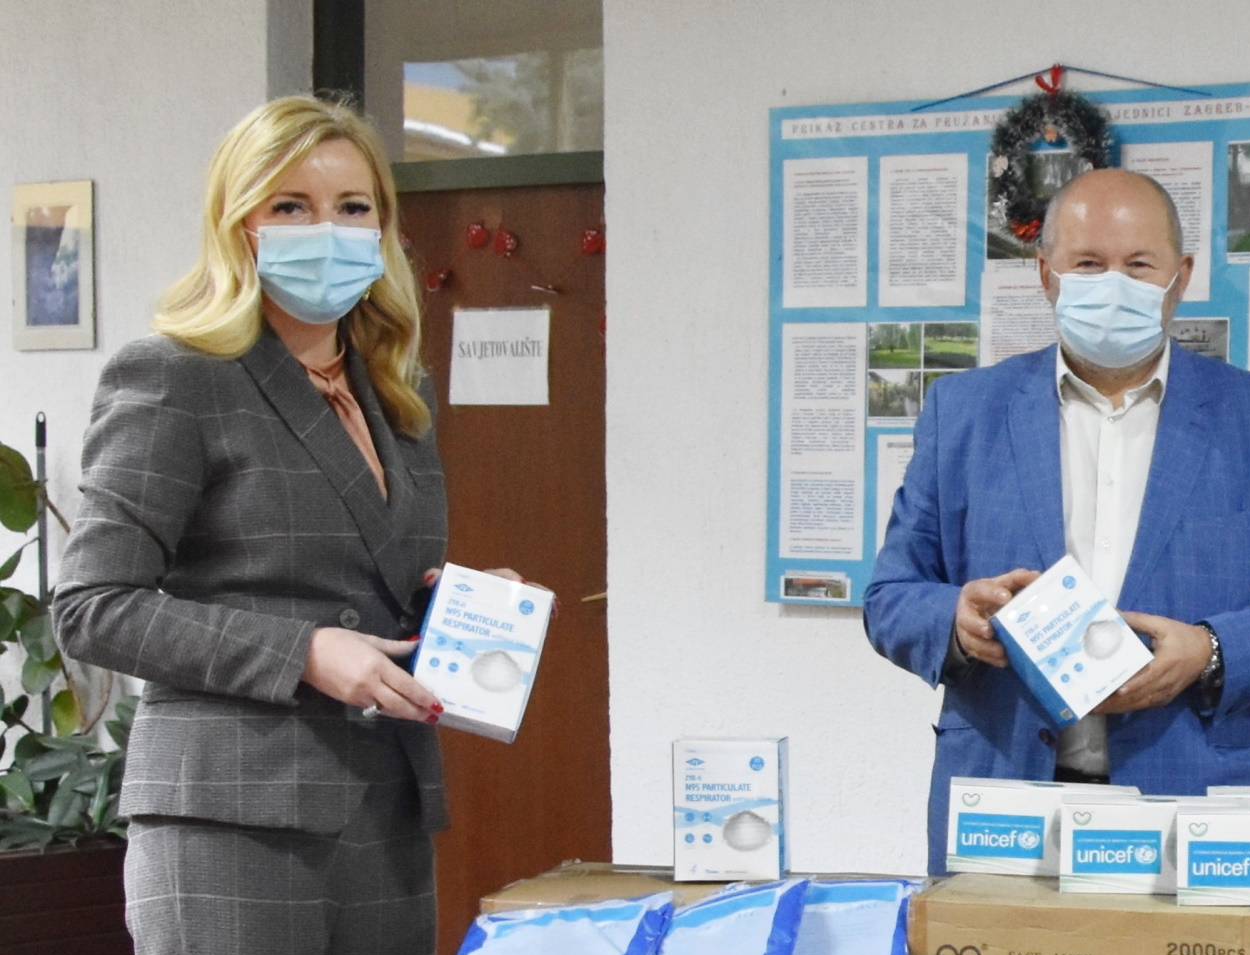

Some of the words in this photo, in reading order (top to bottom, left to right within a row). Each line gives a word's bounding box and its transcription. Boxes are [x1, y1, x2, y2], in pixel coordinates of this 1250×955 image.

[913, 118, 927, 129] ZA
[442, 617, 491, 637] RESPIRATOR
[463, 609, 514, 634] PARTICULATE
[685, 783, 700, 792] N95
[702, 783, 751, 792] PARTICULATE
[685, 793, 731, 802] RESPIRATOR
[961, 830, 1017, 849] unicef
[1077, 845, 1134, 864] unicef
[1192, 858, 1250, 877] unicef
